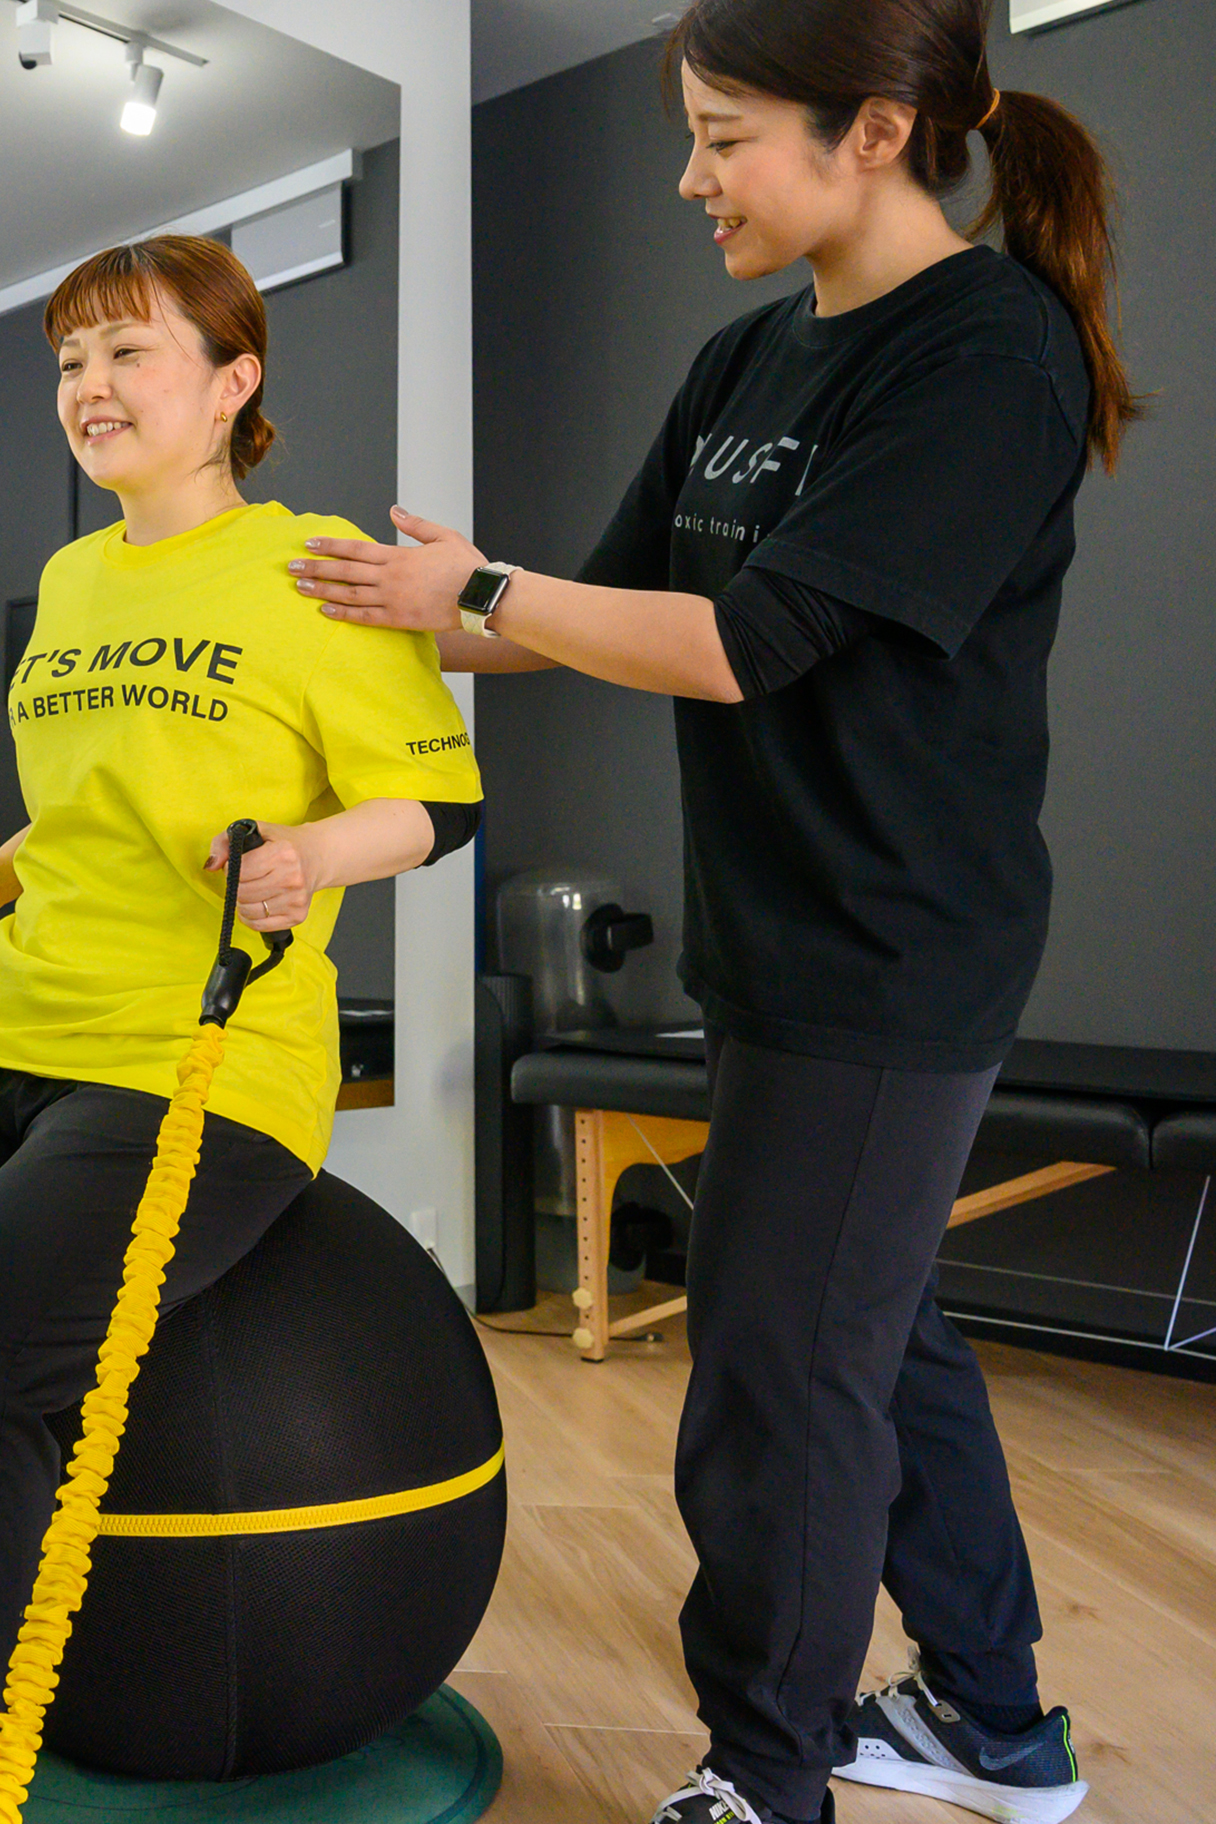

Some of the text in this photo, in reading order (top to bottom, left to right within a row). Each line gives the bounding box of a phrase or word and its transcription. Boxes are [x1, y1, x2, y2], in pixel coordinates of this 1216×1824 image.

[87, 637, 243, 685] MOVE
[17, 701, 29, 723] A
[33, 686, 114, 718] BETTER
[121, 684, 228, 722] WORLD
